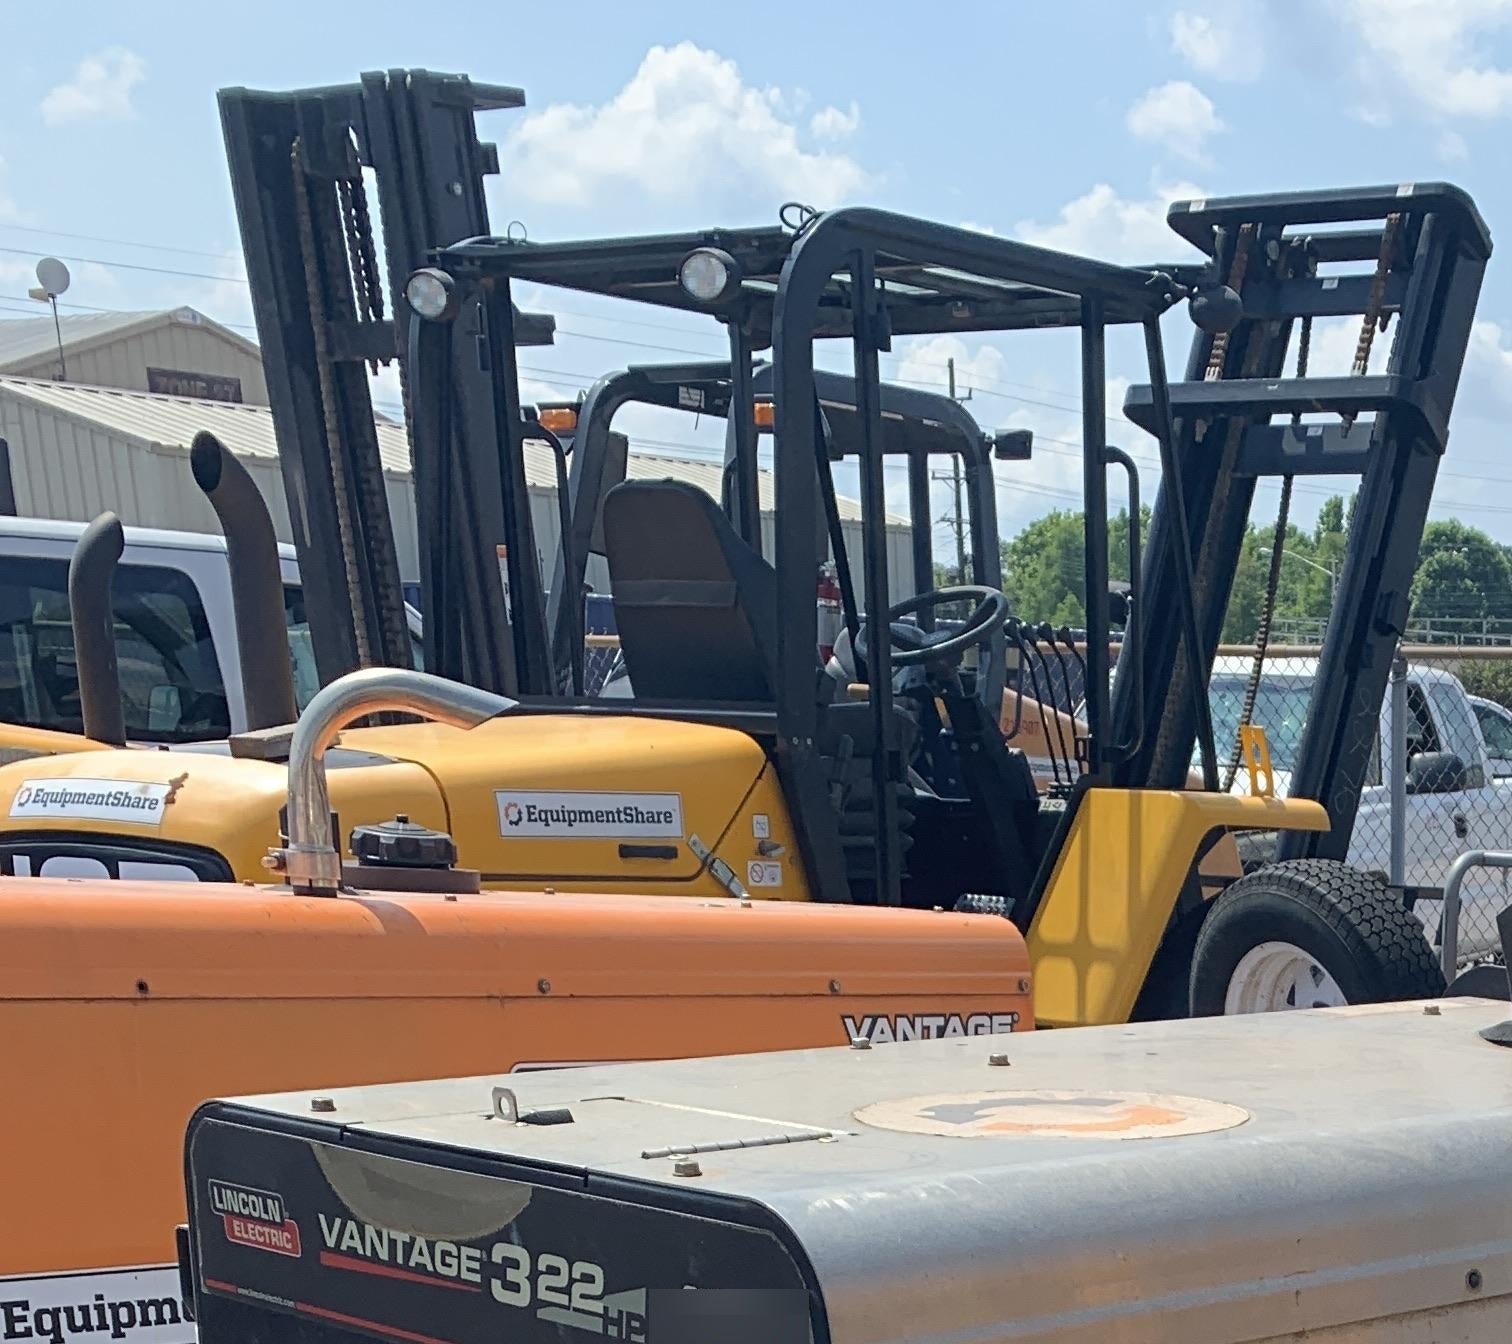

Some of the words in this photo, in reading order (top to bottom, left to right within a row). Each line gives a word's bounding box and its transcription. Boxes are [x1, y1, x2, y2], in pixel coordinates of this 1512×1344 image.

[32, 788, 159, 811] EquipmentShare
[525, 804, 674, 828] EquipmentShare
[213, 1186, 281, 1223] LINCOLN
[233, 1220, 292, 1249] ELECTRIC
[318, 1213, 482, 1283] VANTAGE
[490, 1242, 604, 1312] 322
